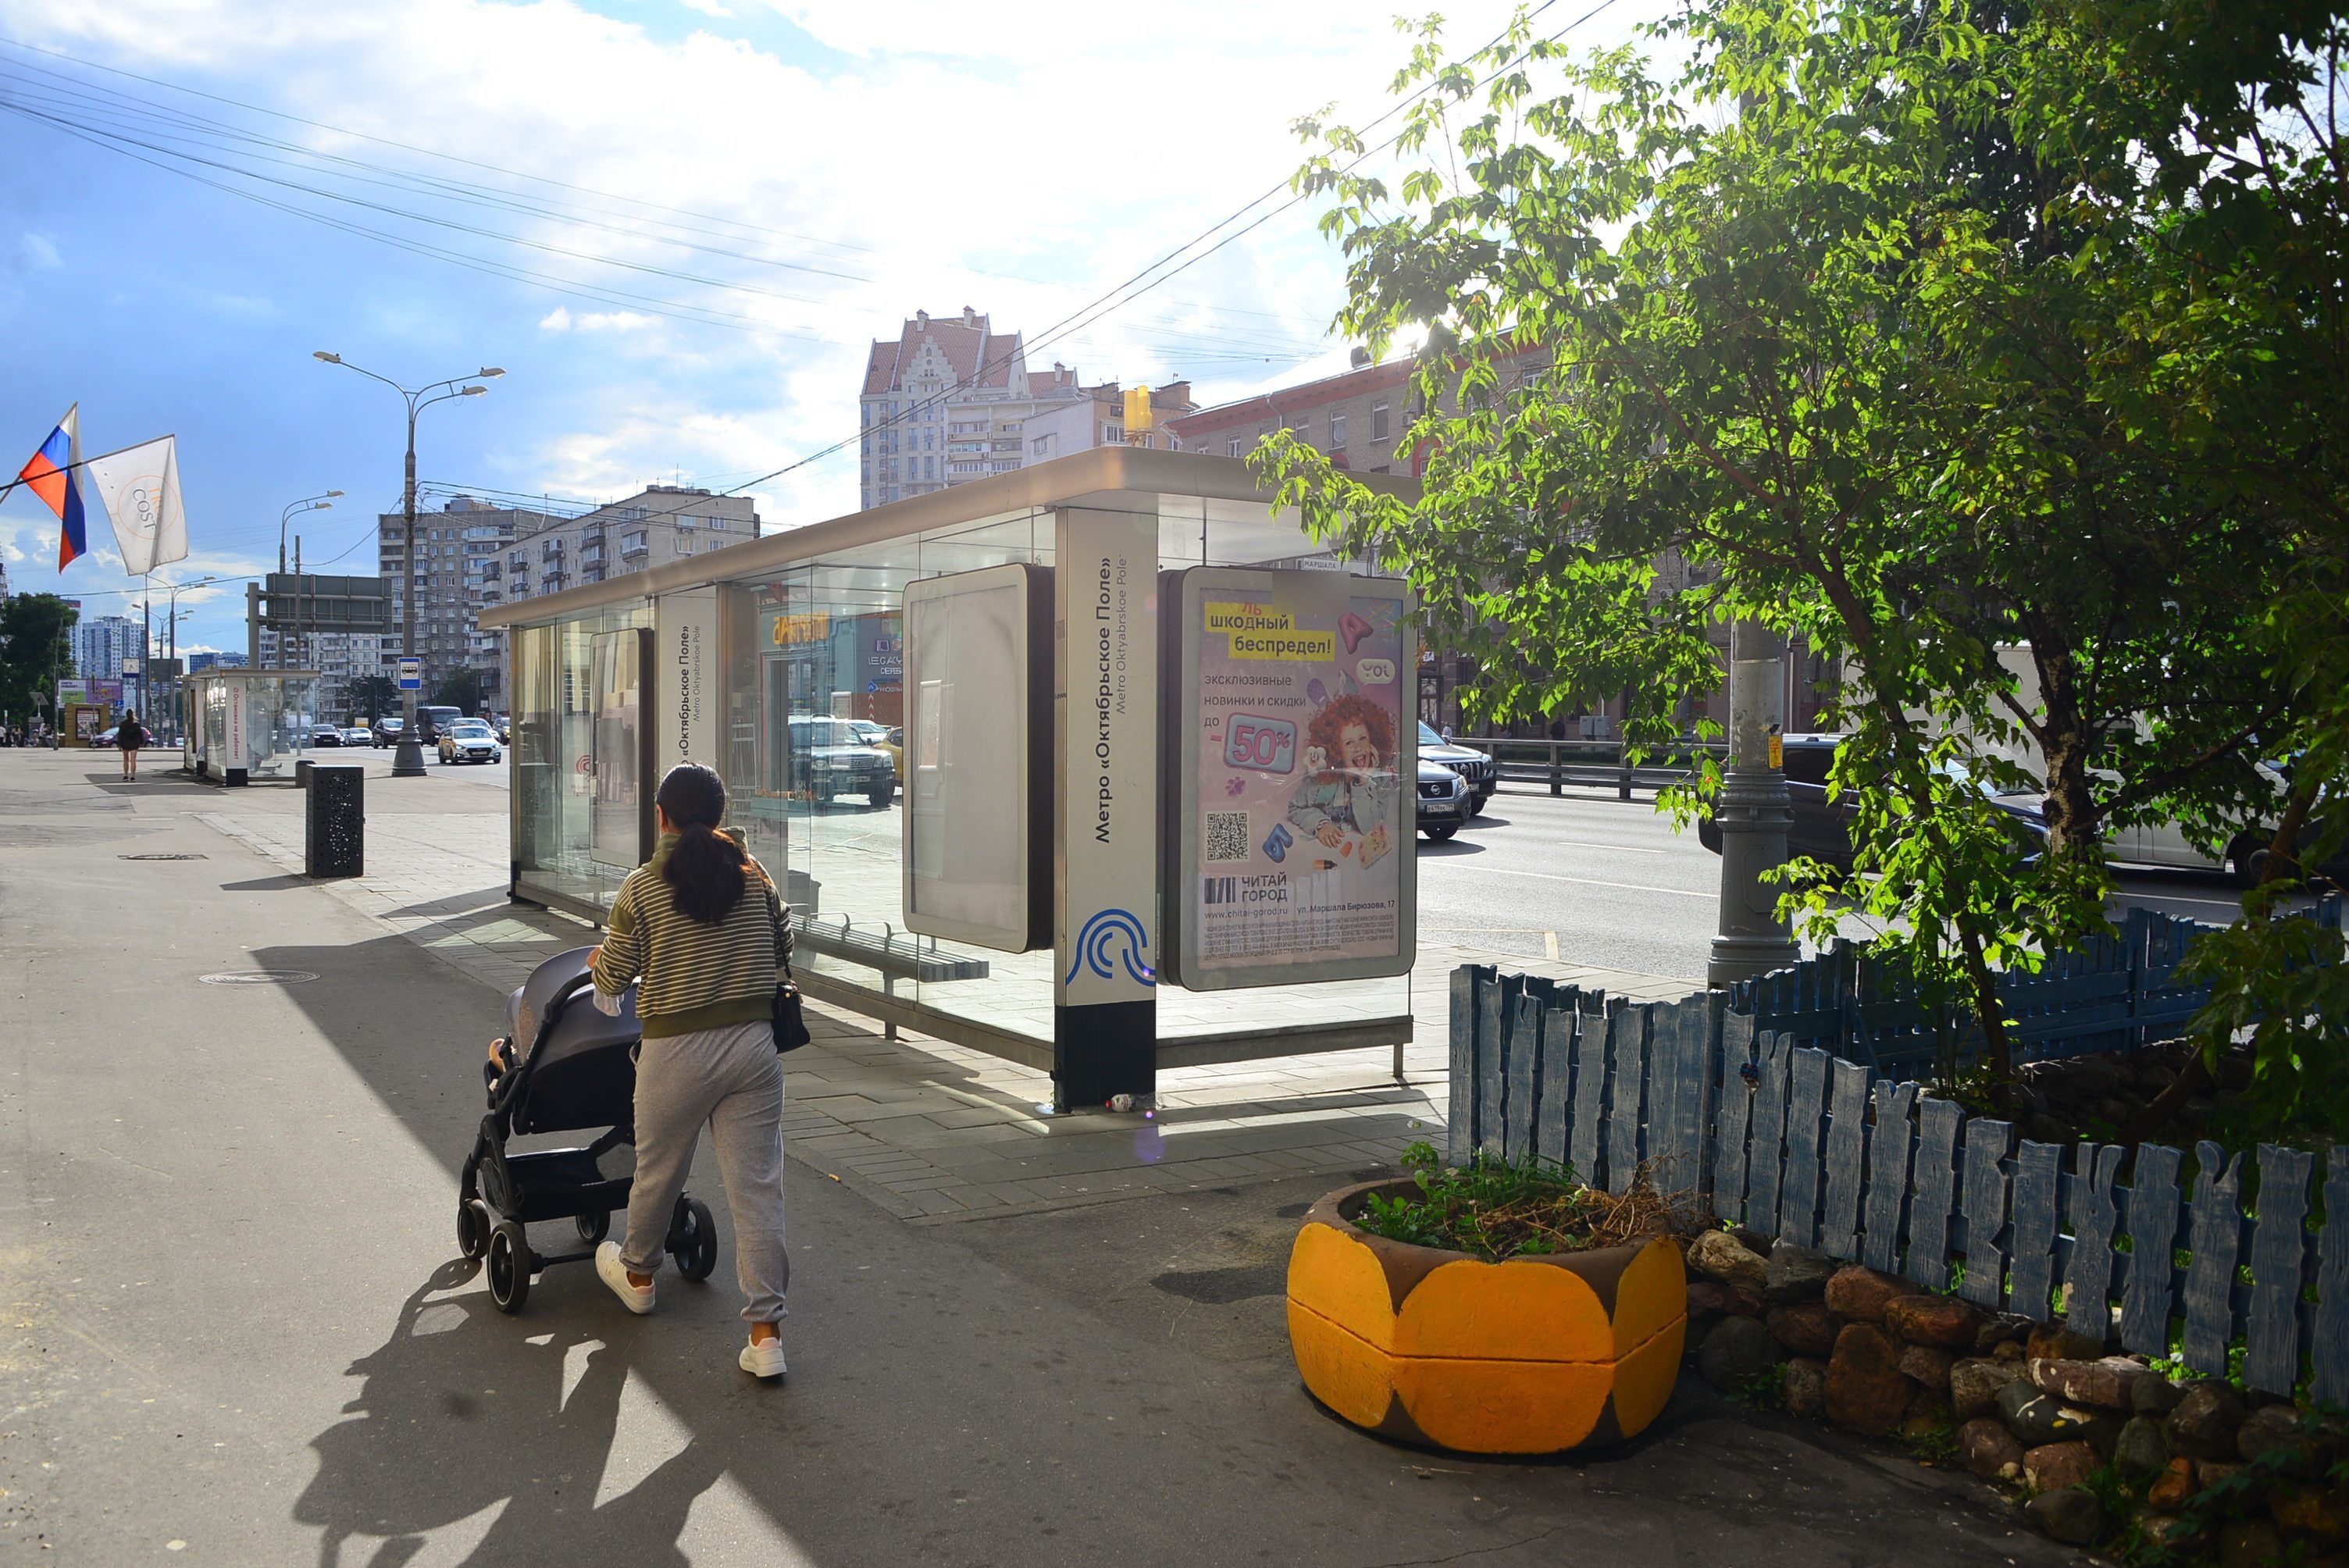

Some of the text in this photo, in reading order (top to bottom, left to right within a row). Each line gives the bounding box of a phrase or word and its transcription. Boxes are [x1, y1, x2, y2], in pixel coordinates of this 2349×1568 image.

[133, 489, 157, 530] COST
[1304, 561, 1336, 569] МАРШАЛА
[1210, 615, 1289, 631] шкодный
[1116, 558, 1128, 715] Metro Oktyabrskoe Pole
[679, 625, 689, 665] Поле»
[1235, 636, 1331, 657] беспредел!
[693, 645, 702, 696] Oktyabrskoe
[1205, 675, 1292, 686] эксклюзивные
[1096, 557, 1113, 844] Метро «Октябрьское Поле»
[1204, 697, 1306, 707] новинки и скидки
[679, 668, 691, 756] «Октябрьское
[1204, 717, 1220, 727] до
[1242, 872, 1287, 888] ЧИТАЙ
[1242, 889, 1288, 903] ГОРОД
[1204, 907, 1288, 919] www.chitai-gorod.ru
[1297, 900, 1395, 915] ул. Маршала Бирюзова, 17
